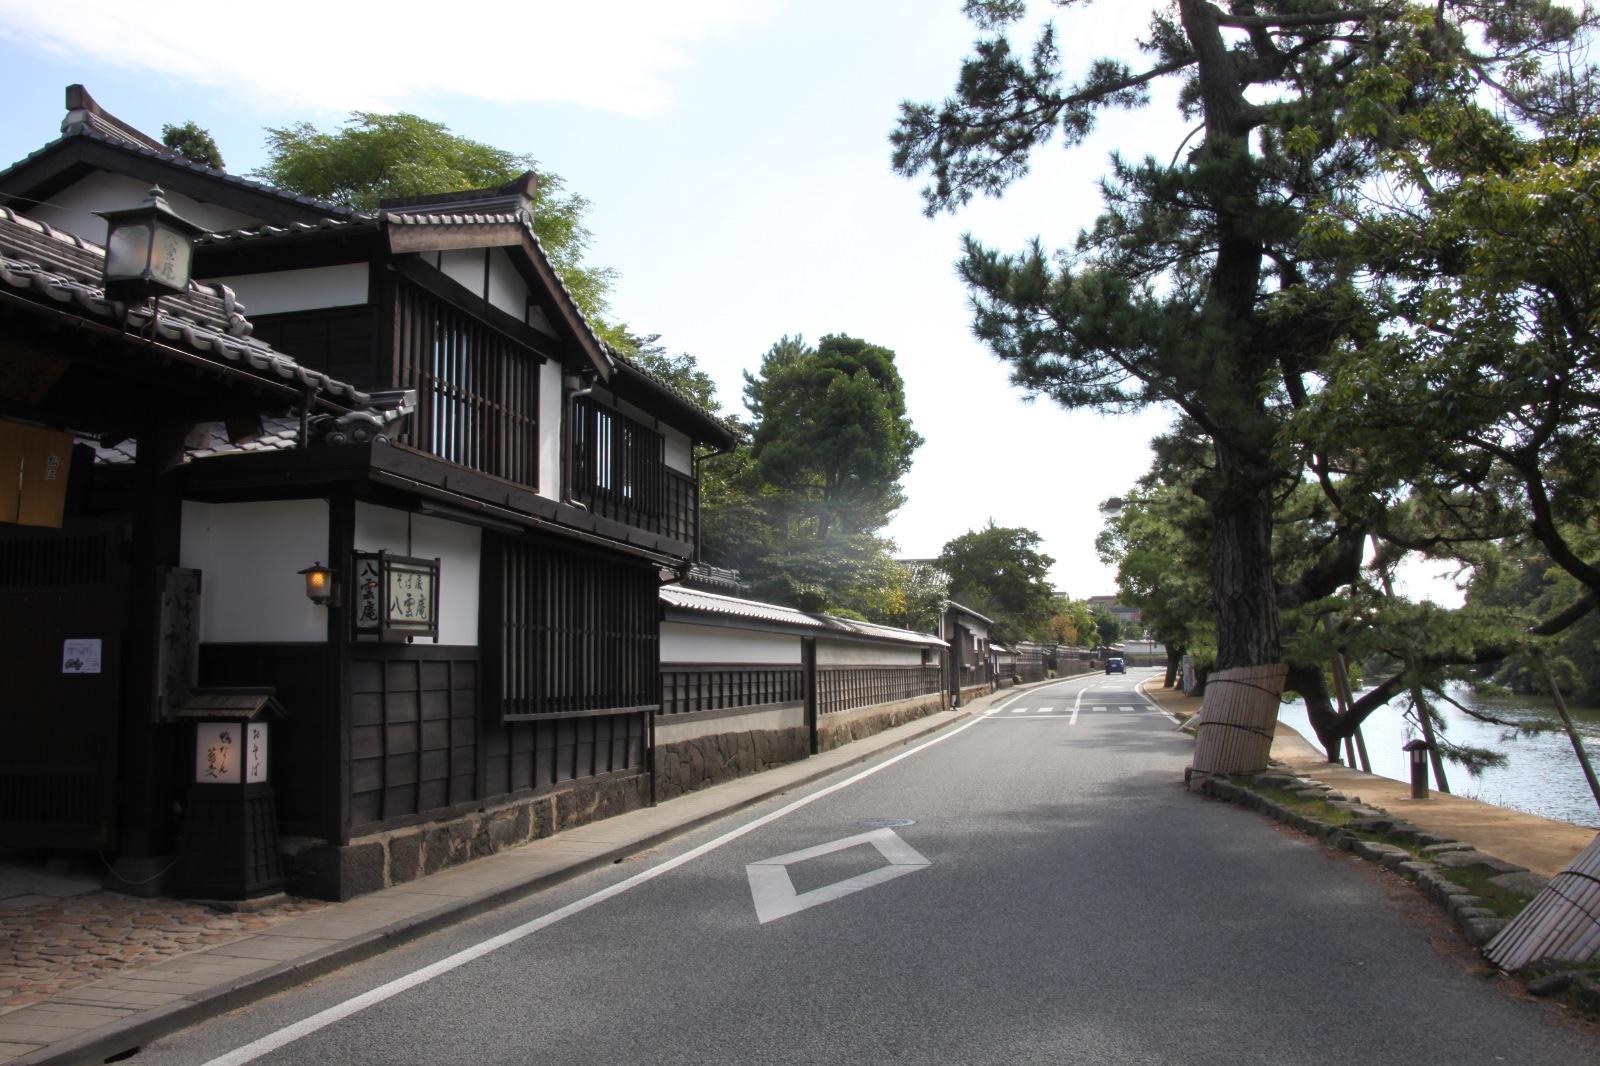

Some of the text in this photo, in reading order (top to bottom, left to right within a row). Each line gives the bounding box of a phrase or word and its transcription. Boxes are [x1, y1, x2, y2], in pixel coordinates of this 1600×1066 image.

[360, 561, 378, 622] 八雲庵
[390, 592, 427, 620] 八雲庵
[251, 728, 261, 777] おそば
